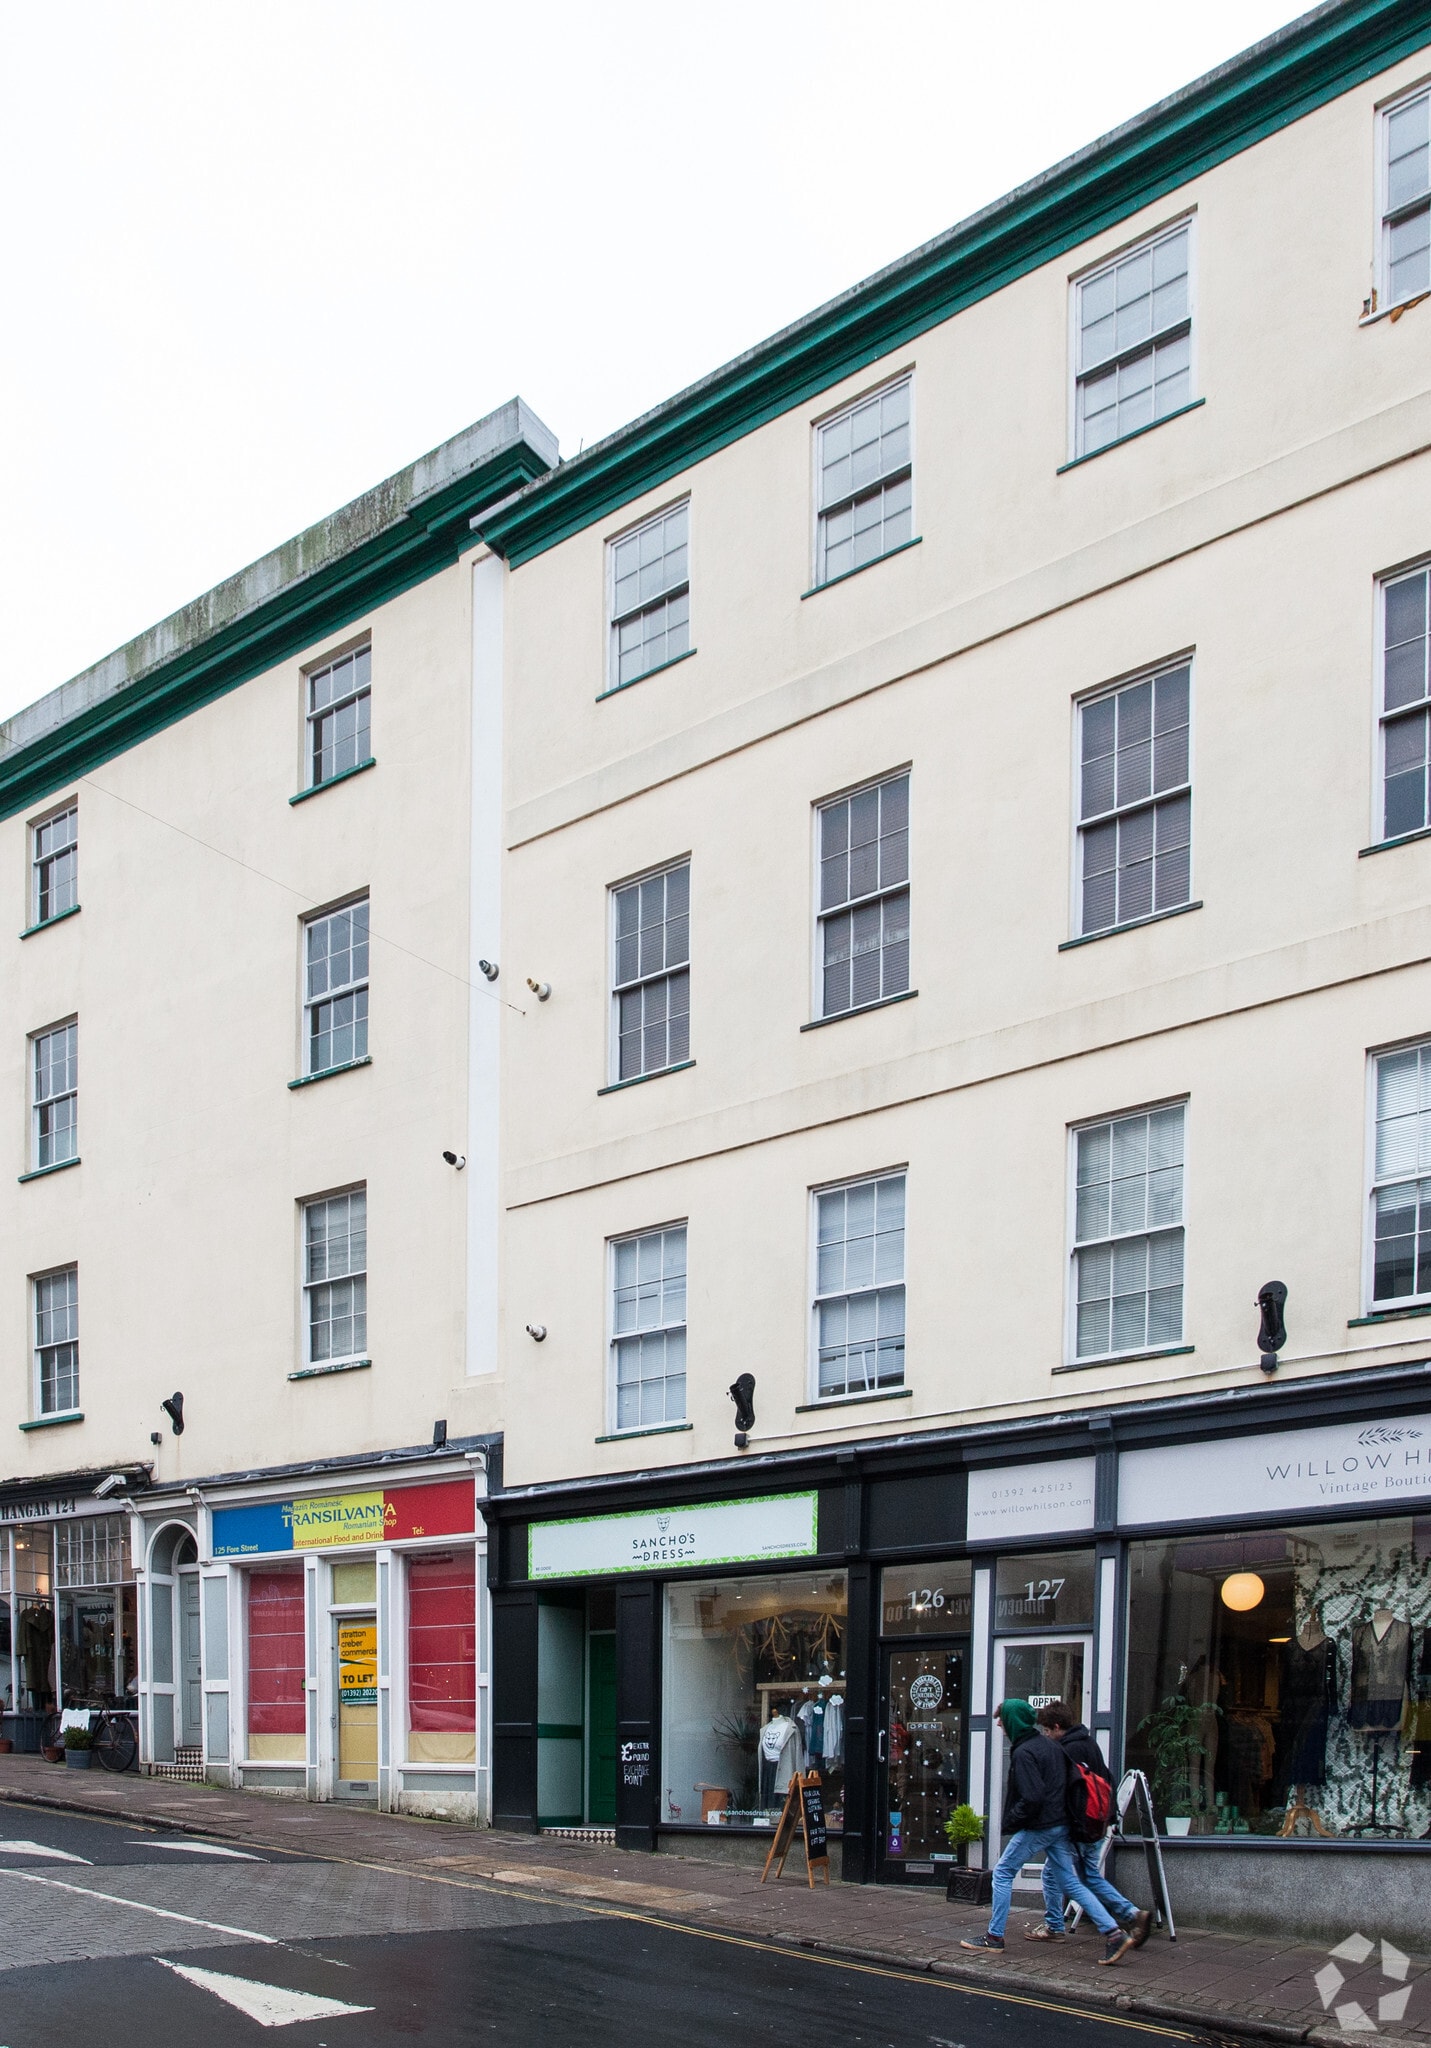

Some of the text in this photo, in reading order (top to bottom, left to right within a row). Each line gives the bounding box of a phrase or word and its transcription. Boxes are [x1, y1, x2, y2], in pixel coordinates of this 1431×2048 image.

[1266, 1453, 1392, 1480] WILLOW
[991, 1482, 1073, 1499] 01392 425123
[1319, 1481, 1378, 1494] Vintage
[1, 1498, 76, 1520] HANGAR 124
[281, 1503, 308, 1513] Magazin
[973, 1498, 1092, 1517] www.willowhilson.com
[281, 1503, 397, 1528] TRANSILVANYA
[343, 1518, 397, 1530] Romanian Shop
[412, 1526, 425, 1535] Tel:
[293, 1530, 384, 1546] International Food and Drink
[632, 1533, 696, 1549] SANCHO'S
[214, 1544, 259, 1555] 125 Fore Street
[643, 1549, 684, 1561] DRESS
[1024, 1578, 1066, 1602] 127
[907, 1587, 945, 1610] 126
[341, 1640, 362, 1648] creber
[343, 1674, 374, 1683] TO LET
[342, 1689, 361, 1697] (01392)
[624, 1774, 643, 1787] POINT
